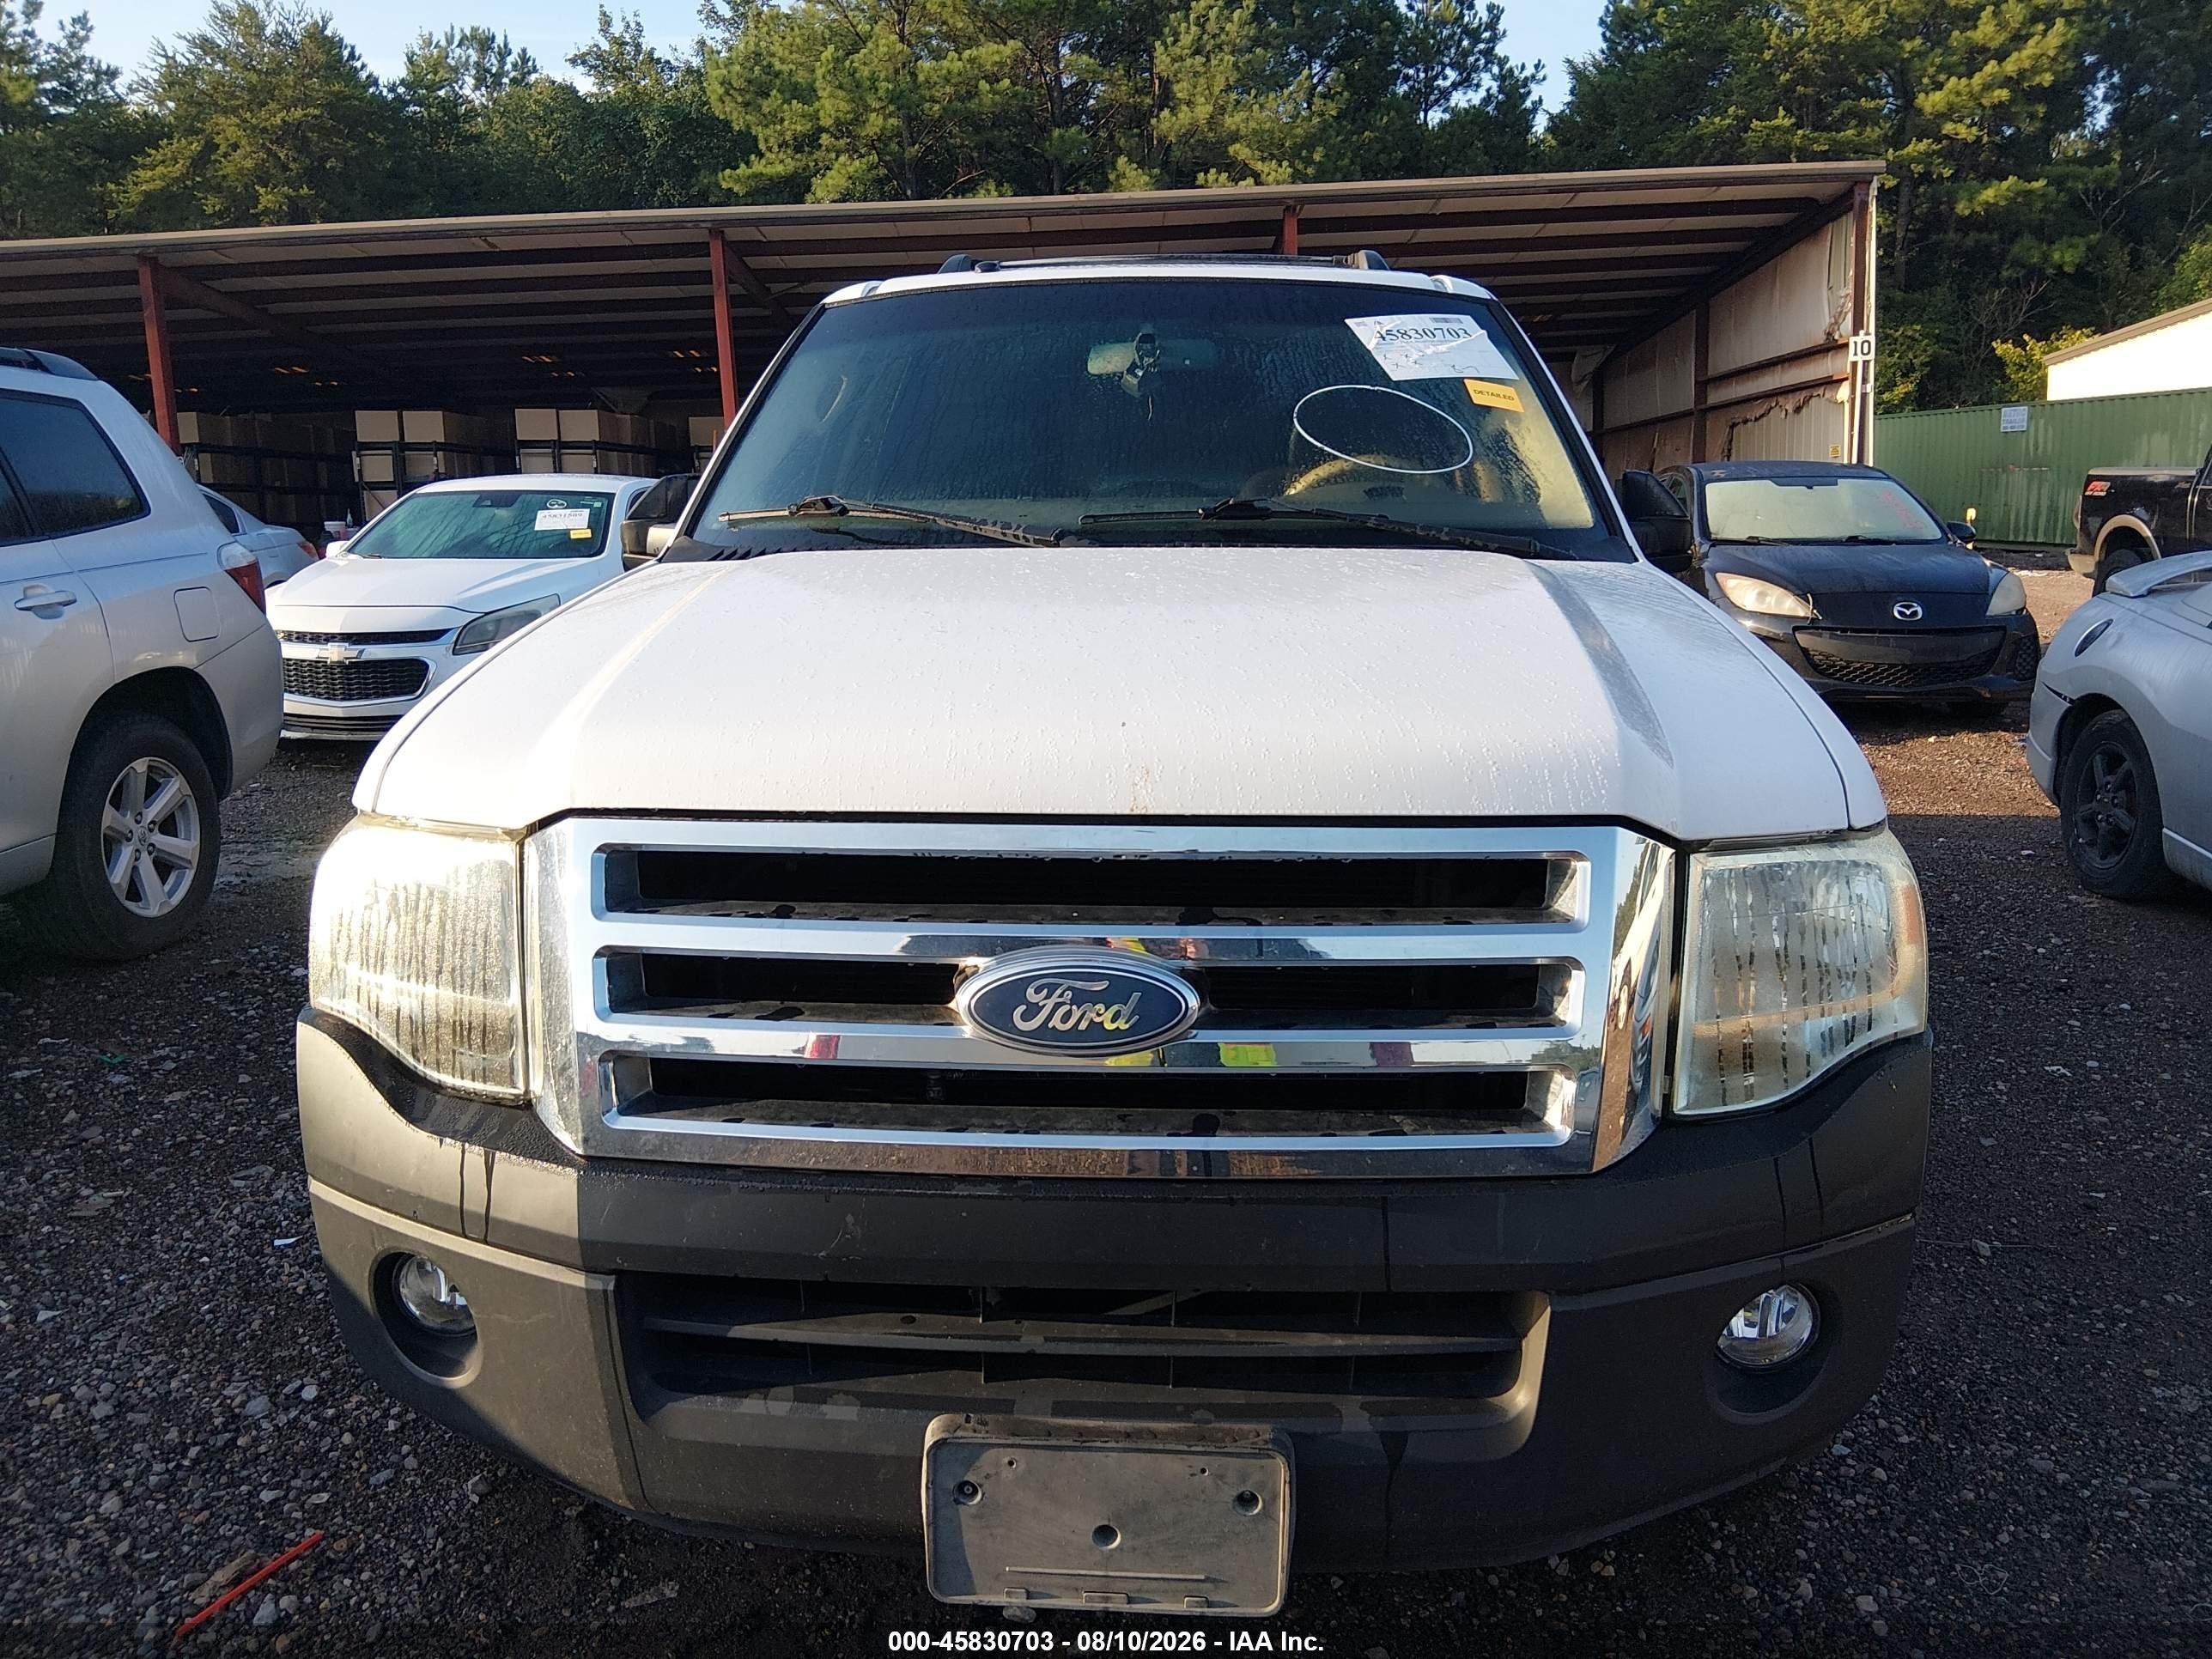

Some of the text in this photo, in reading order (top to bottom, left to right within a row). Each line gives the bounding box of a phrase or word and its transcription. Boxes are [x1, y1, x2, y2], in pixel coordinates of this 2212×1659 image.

[1374, 327, 1472, 341] 45830703
[1852, 339, 1872, 356] 10
[1473, 389, 1515, 401] DETAILED
[1012, 977, 1143, 1031] Ford
